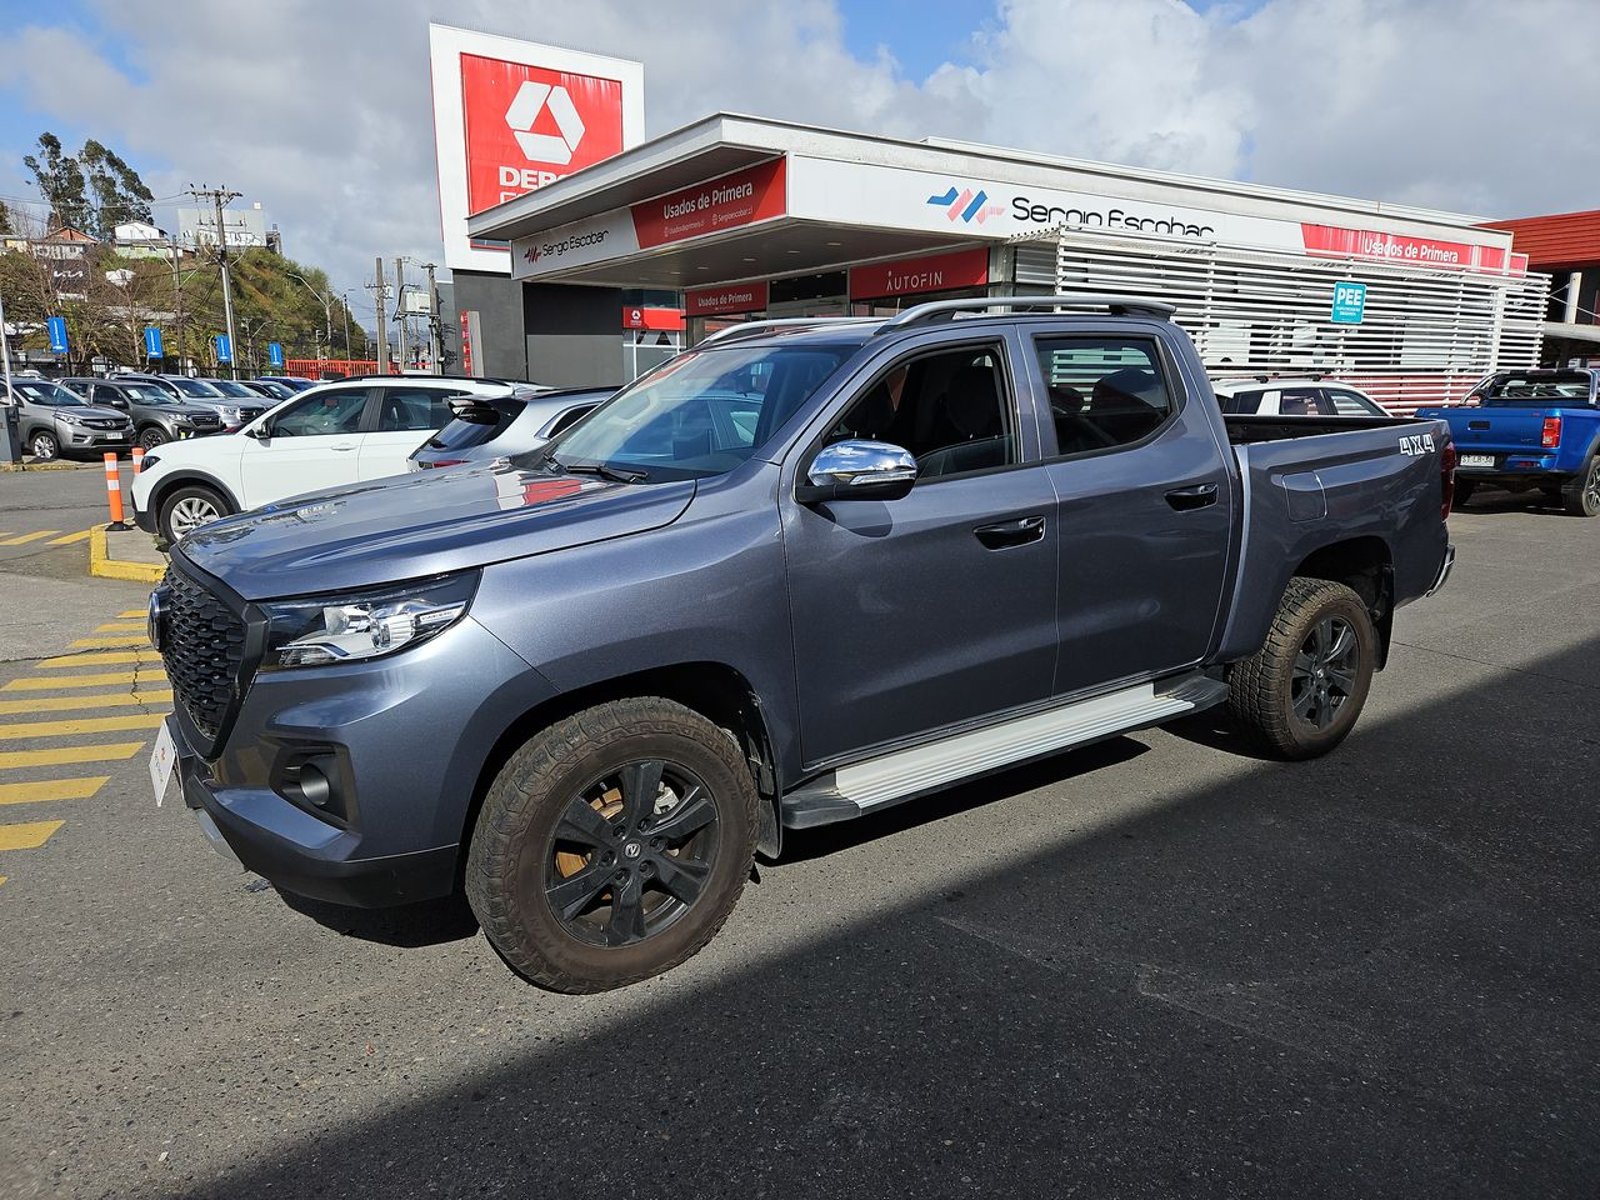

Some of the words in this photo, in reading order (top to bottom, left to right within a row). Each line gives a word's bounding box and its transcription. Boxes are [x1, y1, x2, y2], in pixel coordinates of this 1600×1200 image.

[499, 166, 571, 190] DER
[664, 199, 696, 219] Usados
[697, 193, 710, 210] de
[712, 182, 752, 206] Primera
[1108, 209, 1214, 237] Escobar
[542, 241, 570, 256] Sergio
[570, 230, 609, 250] Escobar
[1364, 239, 1403, 256] Usados
[1405, 243, 1418, 257] de
[1420, 245, 1458, 262] Primera
[698, 297, 719, 307] Usados
[720, 295, 727, 304] de
[729, 293, 752, 304] Primera
[1336, 287, 1363, 305] PEE
